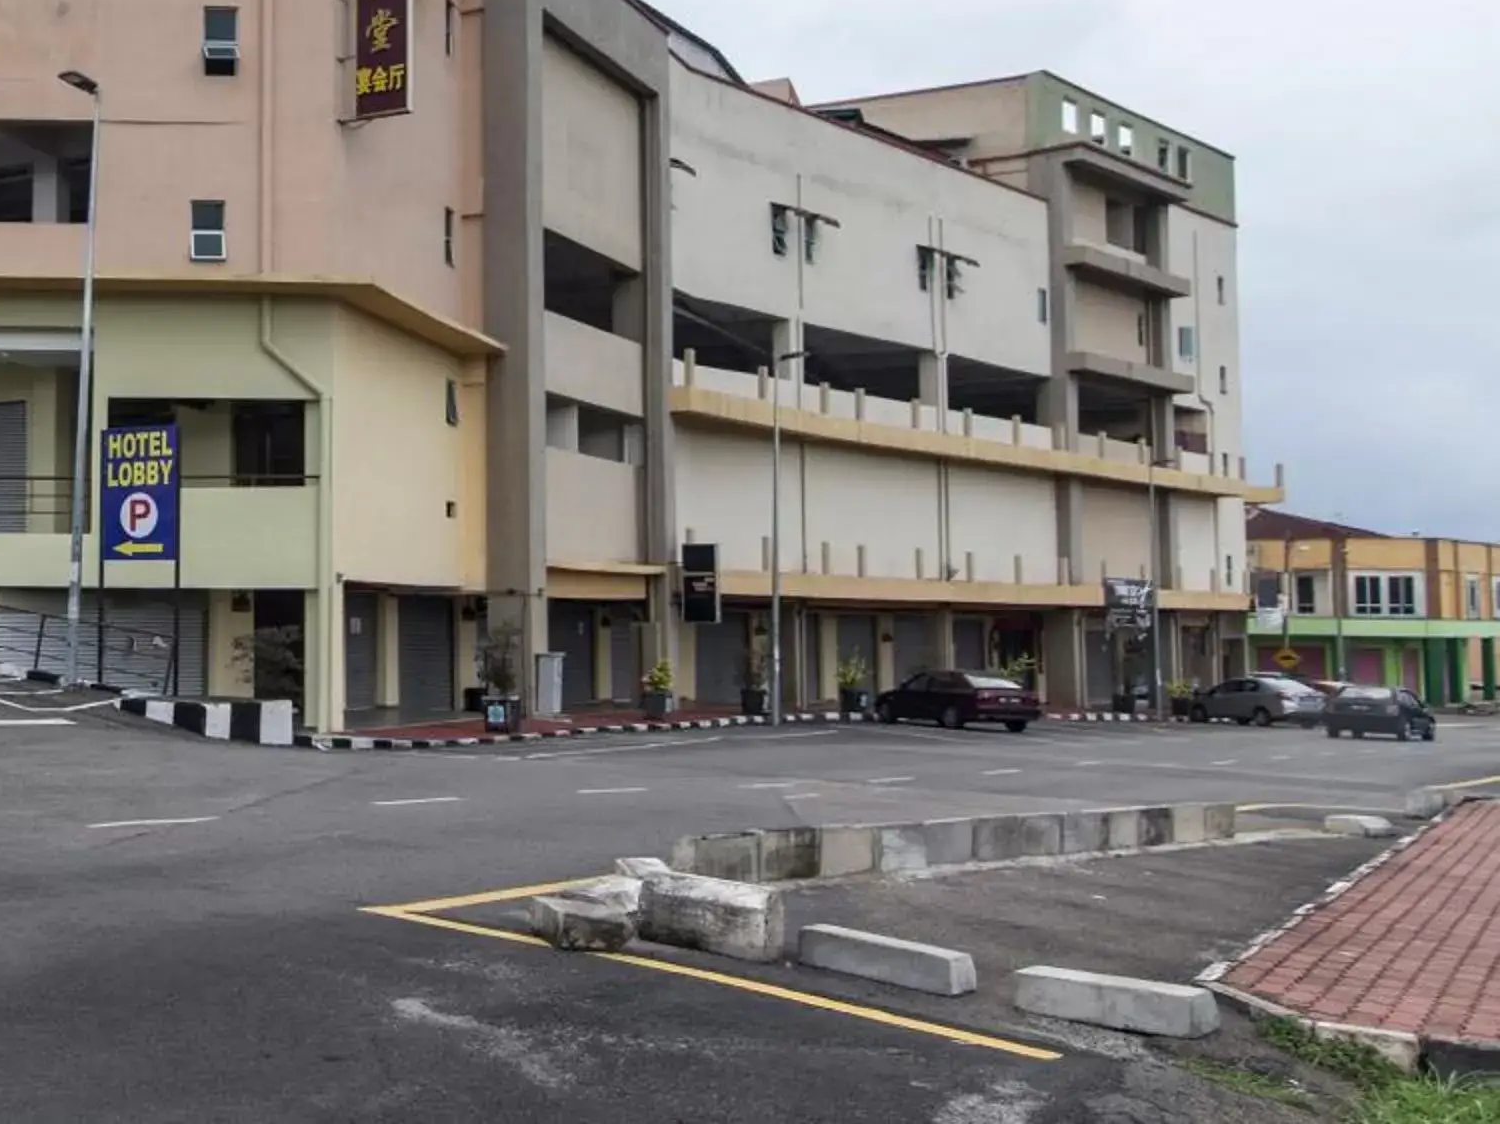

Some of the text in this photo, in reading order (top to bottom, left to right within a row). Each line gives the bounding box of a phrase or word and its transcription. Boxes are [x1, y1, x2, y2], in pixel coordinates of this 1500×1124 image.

[108, 430, 172, 458] HOTEL
[107, 460, 173, 487] LOBBY
[129, 499, 151, 532] P
